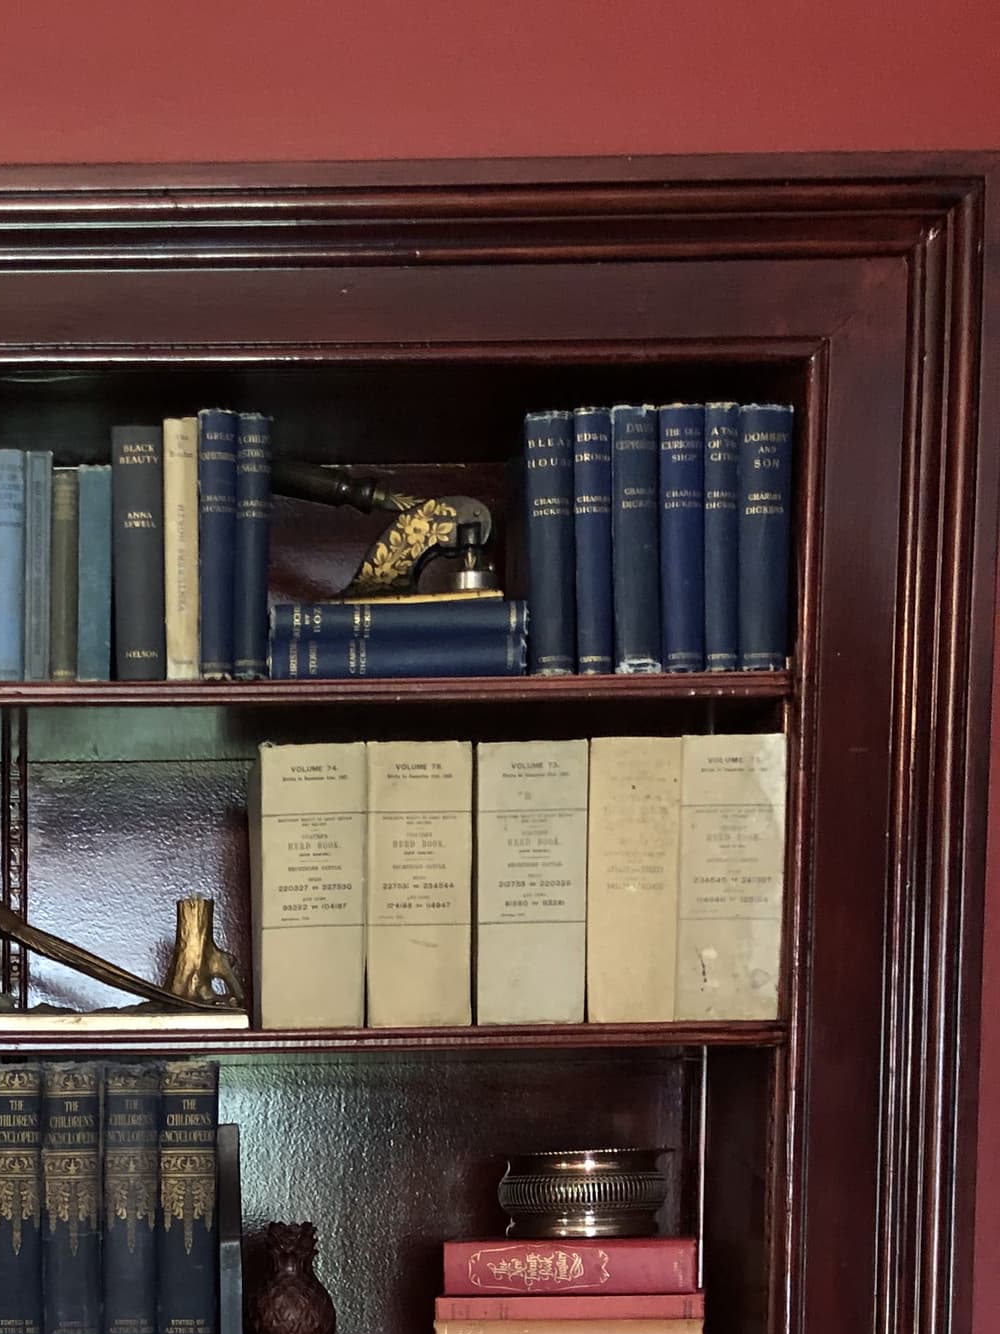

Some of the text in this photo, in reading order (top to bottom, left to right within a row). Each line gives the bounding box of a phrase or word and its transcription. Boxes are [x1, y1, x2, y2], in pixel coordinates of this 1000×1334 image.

[711, 427, 719, 436] A
[744, 432, 787, 443] DOMBEY
[123, 443, 154, 453] BLACK
[528, 438, 570, 449] BLEA
[119, 455, 159, 465] BEAUTY
[527, 458, 570, 469] HOUS
[753, 459, 780, 469] SON
[127, 511, 153, 520] ANNA
[125, 650, 158, 659] NELSON
[290, 765, 322, 773] VOLUME
[395, 763, 427, 771] VOLUME
[511, 762, 544, 770] VOLUME
[9, 1099, 25, 1112] THE
[64, 1100, 80, 1113] THE
[182, 1099, 198, 1111] THE
[50, 1113, 95, 1129] CHILDREN'S
[166, 1112, 212, 1127] CHILDREN'S
